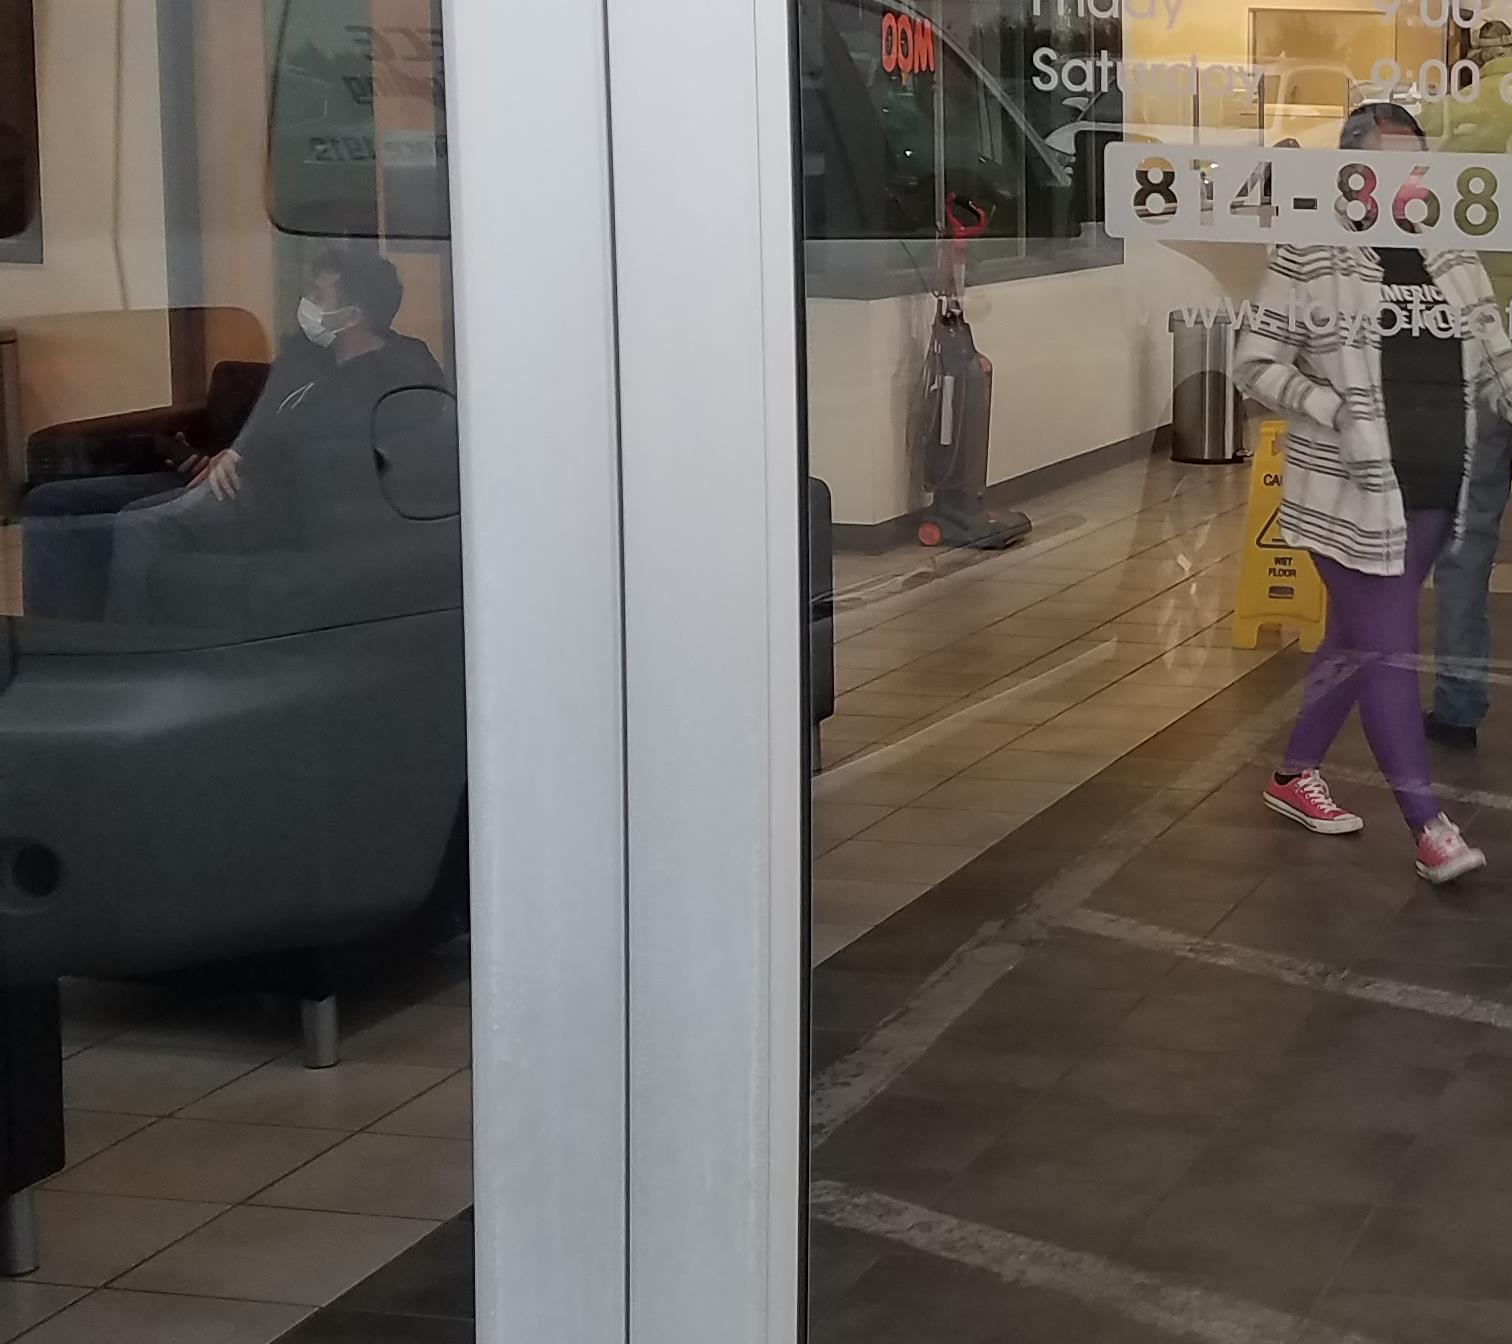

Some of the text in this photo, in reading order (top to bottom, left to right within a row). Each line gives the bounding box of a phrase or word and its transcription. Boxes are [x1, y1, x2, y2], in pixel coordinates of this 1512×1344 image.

[882, 12, 935, 74] OOM
[1031, 46, 1266, 105] Saturday
[1370, 57, 1481, 104] 9:00
[1268, 567, 1297, 578] FLOOR
